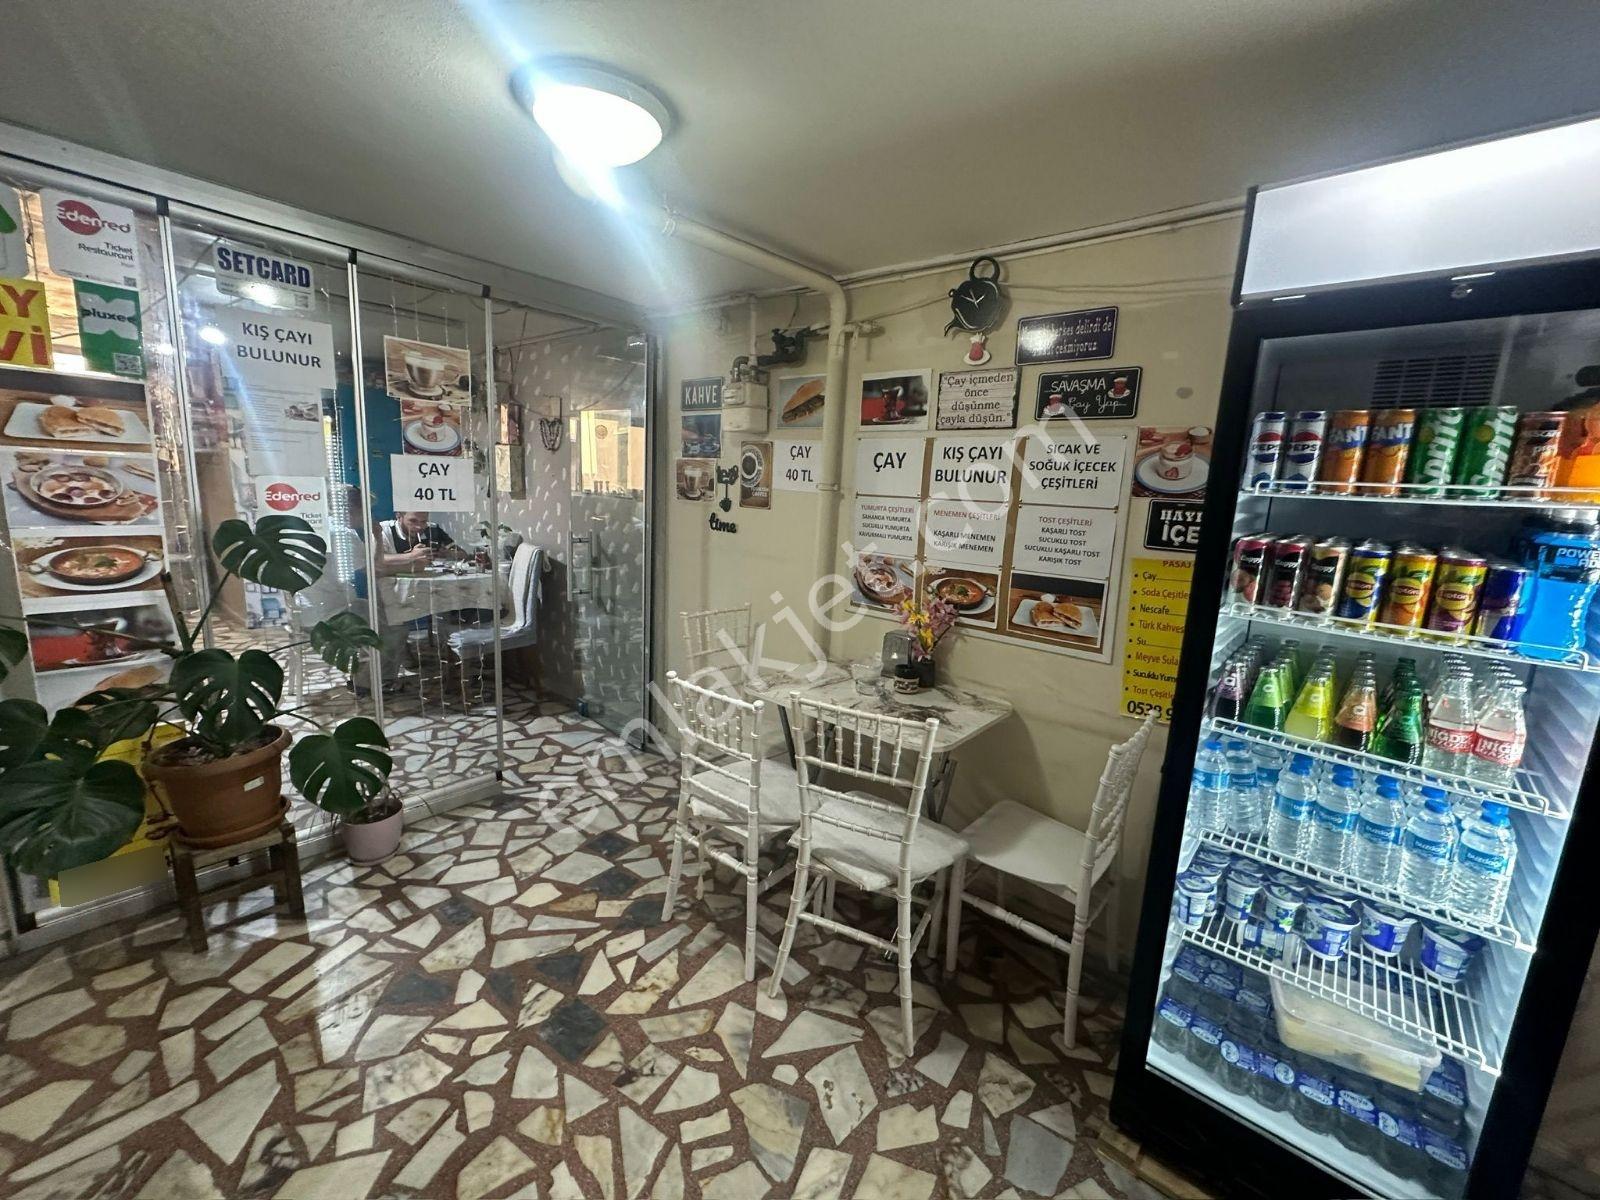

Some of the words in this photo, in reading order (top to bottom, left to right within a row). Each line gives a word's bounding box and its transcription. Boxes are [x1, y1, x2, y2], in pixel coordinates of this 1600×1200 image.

[56, 207, 131, 233] Edenred
[217, 246, 311, 288] SETCARD
[0, 284, 39, 318] Y
[242, 322, 270, 339] KIŞ
[275, 328, 313, 346] ÇAYI
[237, 344, 322, 368] BULUNUR
[969, 372, 1015, 386] içmeden
[1050, 376, 1106, 395] SAVAŞMA
[684, 384, 718, 406] KAHVE
[964, 388, 989, 398] önce
[951, 400, 1000, 412] düşünme
[940, 413, 967, 426] çayla
[790, 445, 812, 461] ÇAY
[942, 446, 964, 462] KIŞ
[968, 445, 1003, 462] ÇAYI
[1046, 443, 1082, 454] SICAK
[1084, 444, 1101, 455] VE
[873, 451, 907, 472] ÇAY
[1029, 459, 1071, 472] SOĞUK
[1073, 459, 1117, 474] İÇECEK
[418, 462, 450, 479] ÇAY
[785, 469, 799, 482] 40
[801, 470, 814, 482] TL
[934, 469, 1007, 484] BULUNUR
[1040, 476, 1099, 491] ÇEŞİTLERİ
[265, 491, 321, 502] Edenred
[413, 487, 434, 501] 40
[438, 488, 457, 501] TL
[861, 504, 887, 512] YUMURTA
[888, 506, 915, 514] ÇEŞİTLERİ
[933, 509, 968, 519] MENEMEN
[708, 512, 737, 534] time
[885, 515, 911, 523] YUMURTA
[1039, 516, 1056, 524] TOST
[1057, 517, 1094, 527] ÇEŞİTLERİ
[884, 524, 910, 532] YUMURTA
[1041, 527, 1068, 536] KAŞARLI
[1069, 529, 1087, 537] TOST
[1161, 520, 1201, 547] İÇE
[887, 533, 912, 542] YUMURTA
[933, 530, 959, 539] KAŞARLI
[960, 532, 996, 542] MENEMEN
[1038, 536, 1068, 545] SUCUKLU
[1069, 538, 1087, 547] TOST
[958, 543, 994, 553] MENEMEN
[1024, 544, 1053, 554] SUCUKLU
[1054, 547, 1081, 556] KAŞARLI
[1082, 550, 1101, 558] TOST
[1038, 555, 1063, 565] KARIŞIK
[1064, 558, 1082, 566] TOST
[1162, 560, 1192, 569] PASAJ
[1142, 571, 1157, 582] Çay
[1141, 587, 1160, 597] Soda
[1139, 603, 1170, 615] Nescafe
[1139, 619, 1155, 630] Türk
[1136, 636, 1147, 646] Su
[1135, 651, 1160, 664] Meyve
[1132, 685, 1148, 695] Tost
